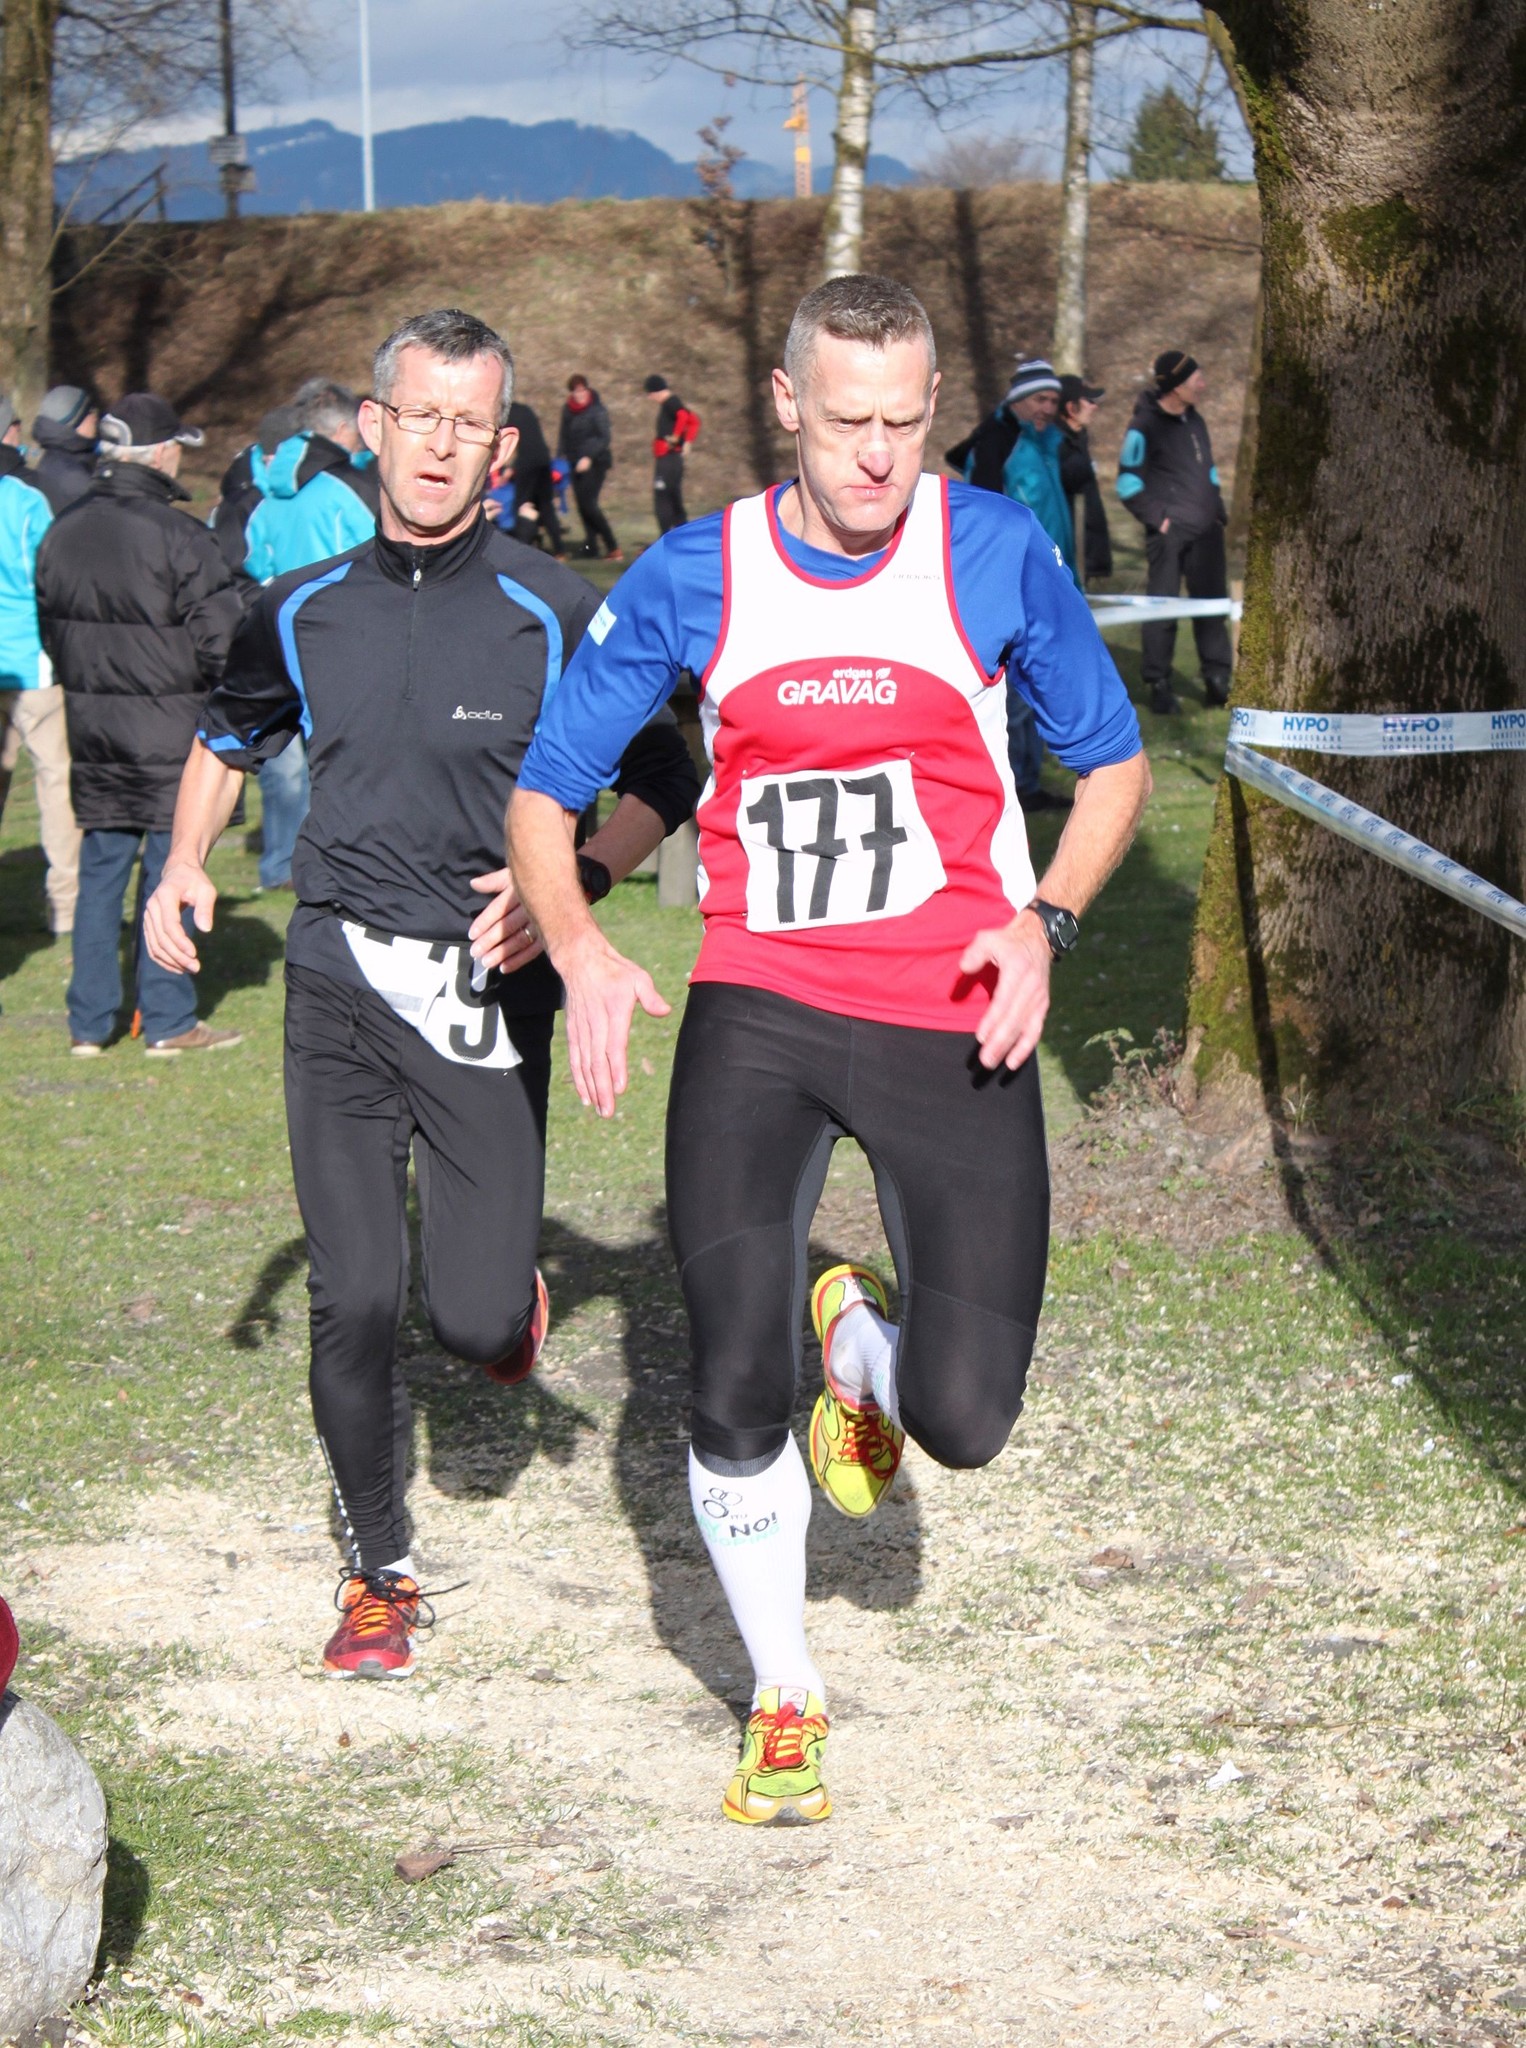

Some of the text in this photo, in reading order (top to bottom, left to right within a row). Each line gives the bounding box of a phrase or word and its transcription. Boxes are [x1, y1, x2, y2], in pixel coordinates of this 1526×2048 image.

[832, 667, 873, 681] erdgas
[777, 680, 898, 706] GRAVAG
[467, 710, 503, 721] odlo
[1283, 716, 1330, 732] HYPO
[1383, 716, 1440, 733] HYPO
[1491, 713, 1526, 730] HYPO
[746, 772, 908, 924] 177
[729, 1511, 778, 1538] NO!
